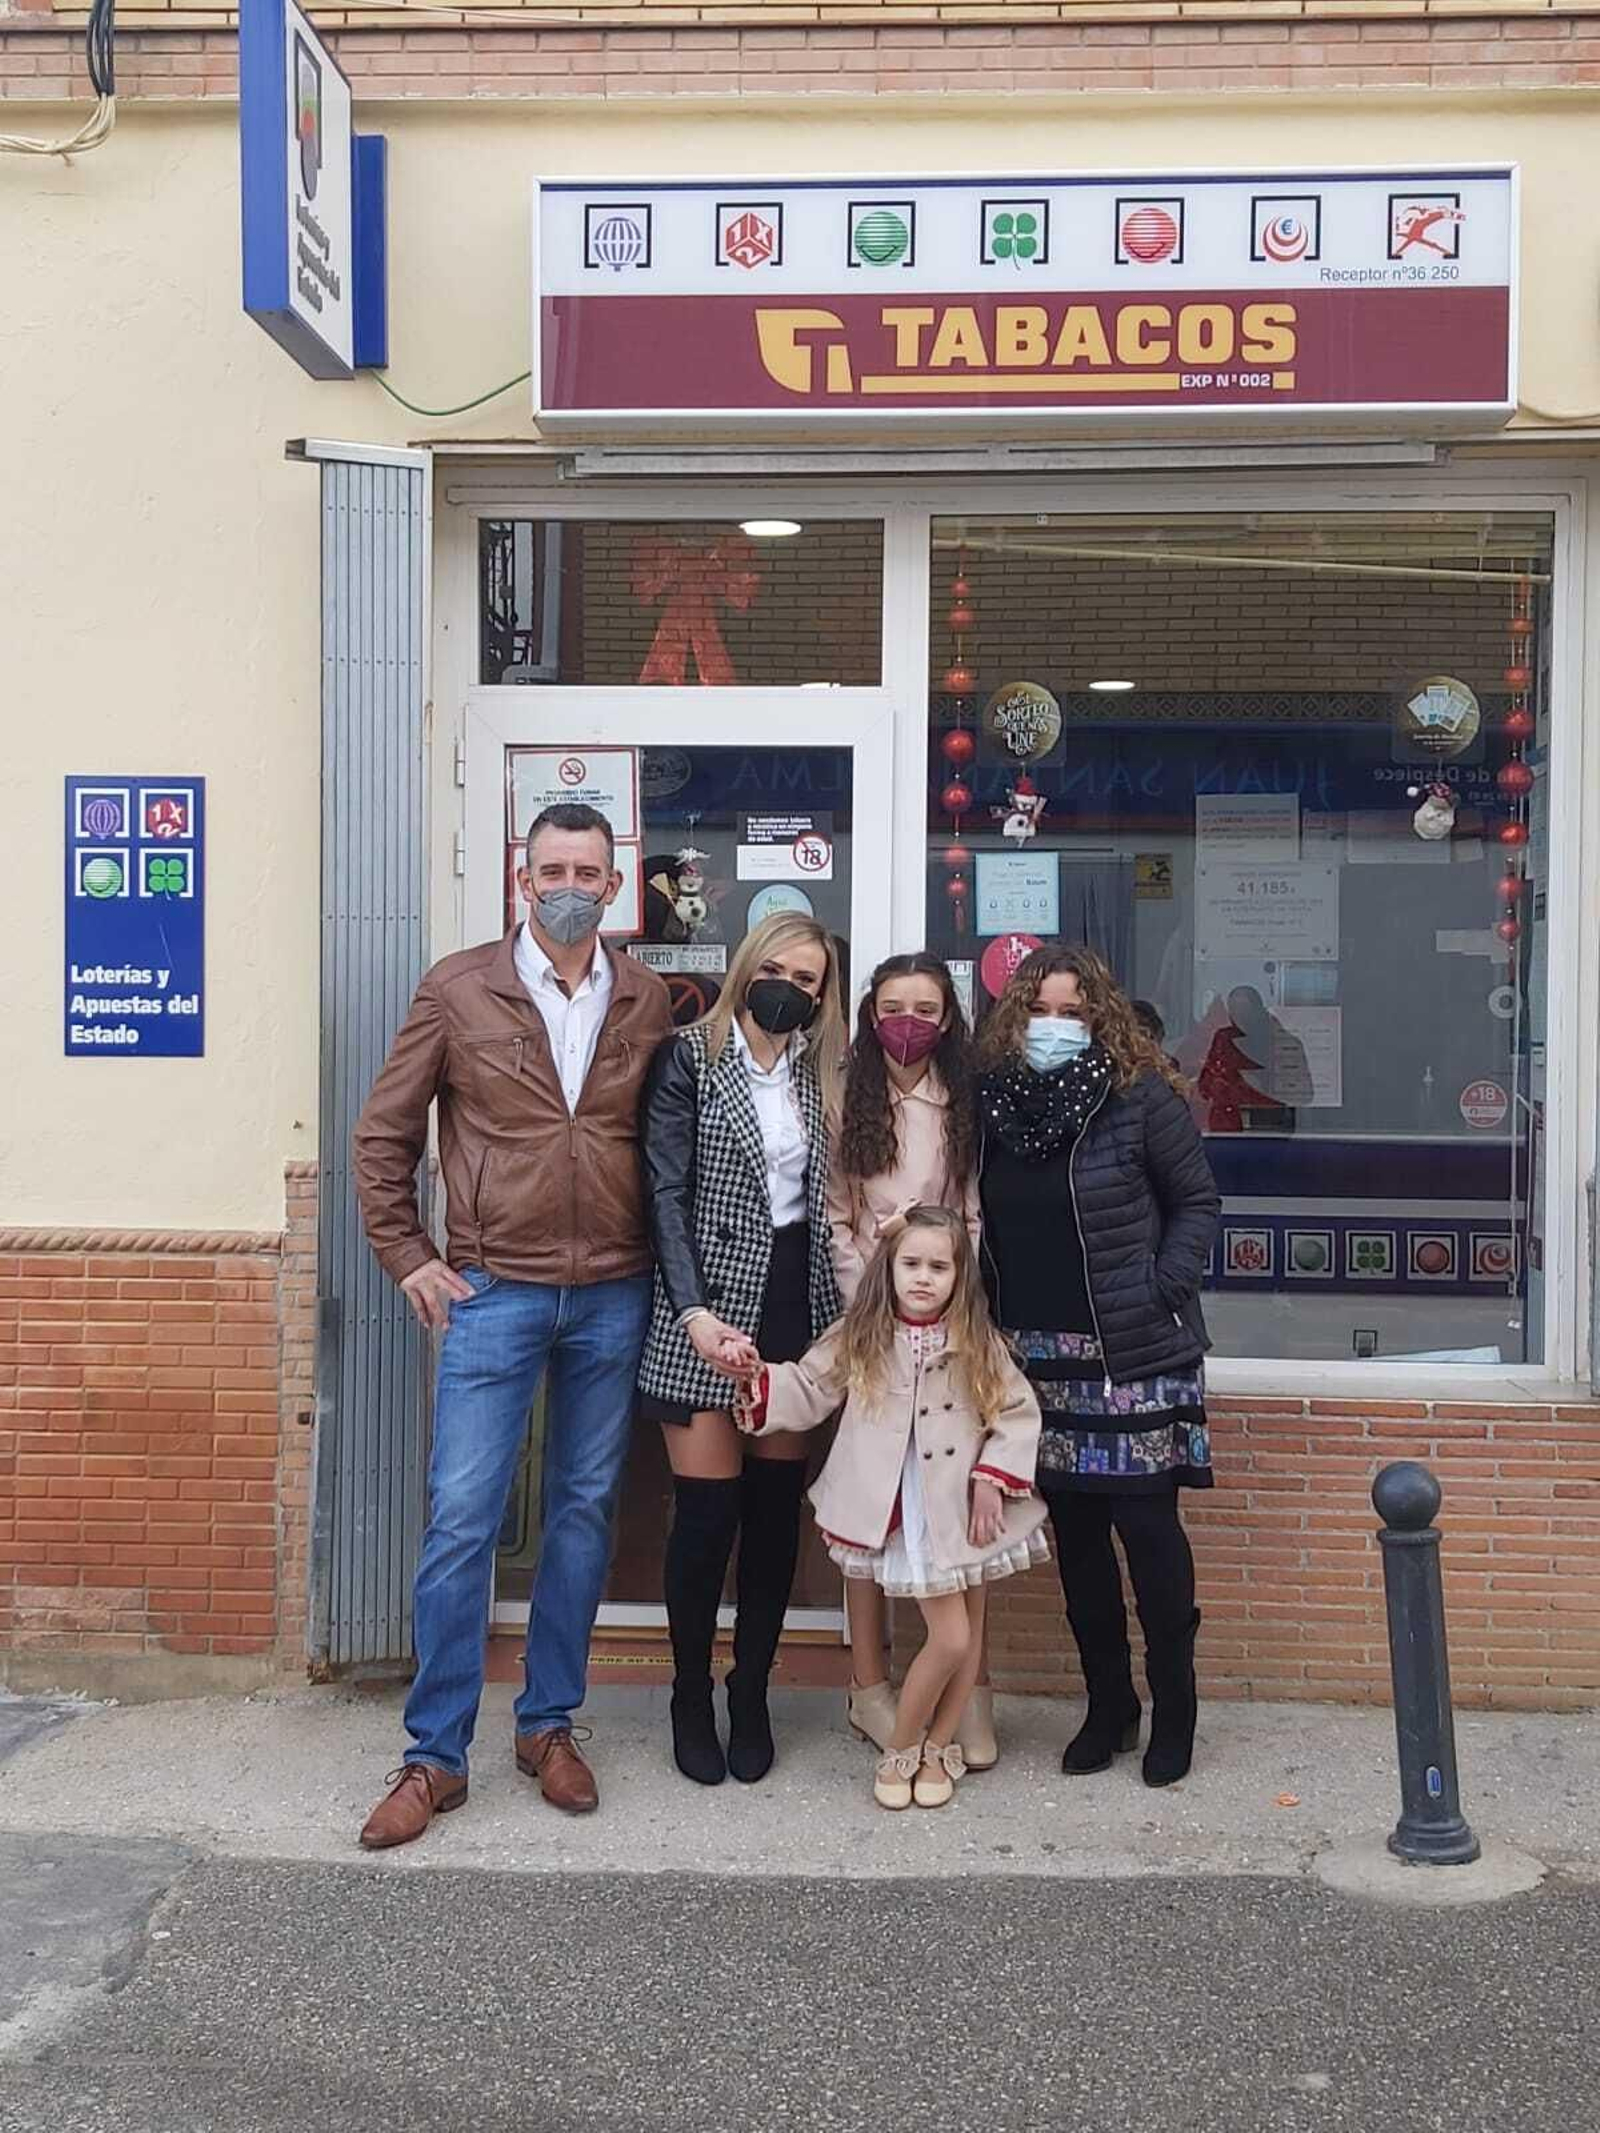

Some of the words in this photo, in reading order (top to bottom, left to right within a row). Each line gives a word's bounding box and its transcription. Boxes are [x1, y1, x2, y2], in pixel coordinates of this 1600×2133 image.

[1320, 267, 1387, 282] Receptor
[882, 304, 1297, 367] TABACOS
[1181, 374, 1212, 388] EXP
[1239, 373, 1271, 386] 002
[71, 964, 152, 983] Loterías
[157, 969, 170, 989] y
[70, 995, 162, 1018] Apuestas
[167, 994, 199, 1014] del
[71, 1024, 140, 1044] Estado
